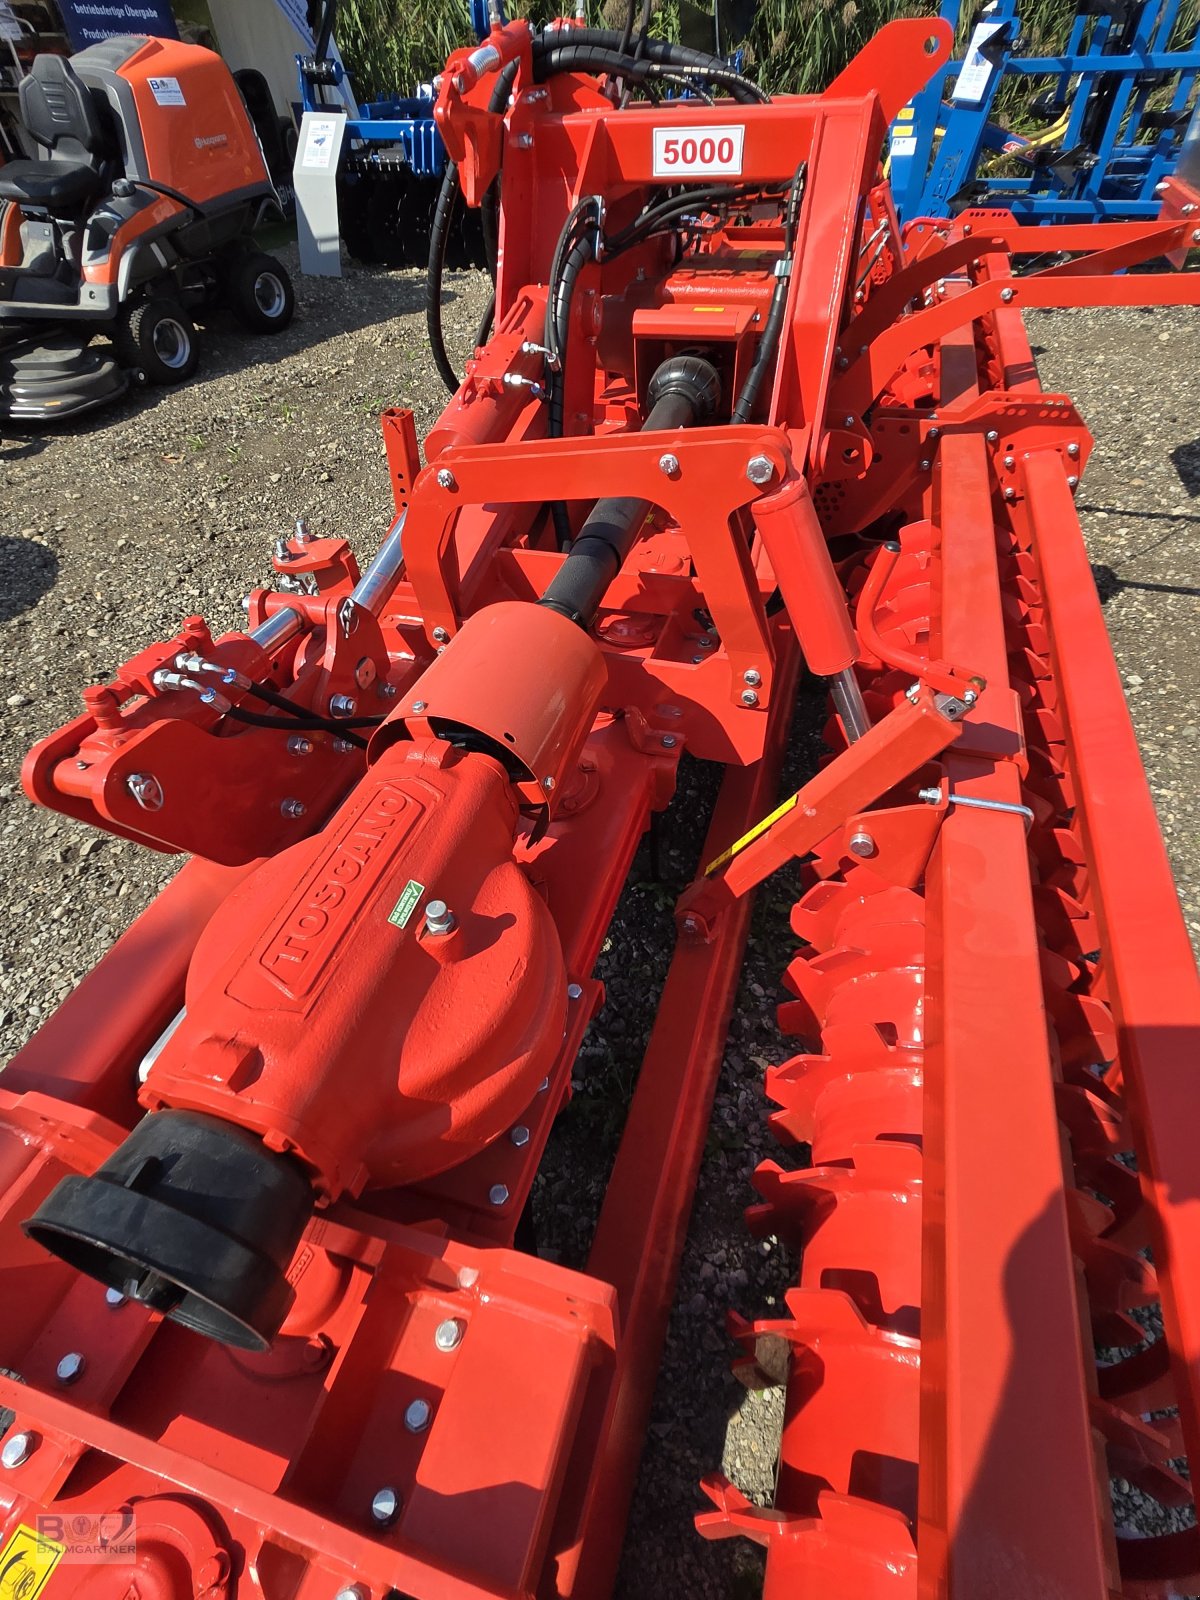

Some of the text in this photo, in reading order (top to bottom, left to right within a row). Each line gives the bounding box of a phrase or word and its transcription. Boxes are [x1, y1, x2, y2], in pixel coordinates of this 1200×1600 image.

[73, 3, 159, 20] betriebsfertige Übergabe
[663, 137, 734, 165] 5000
[271, 794, 408, 966] TOSCANO
